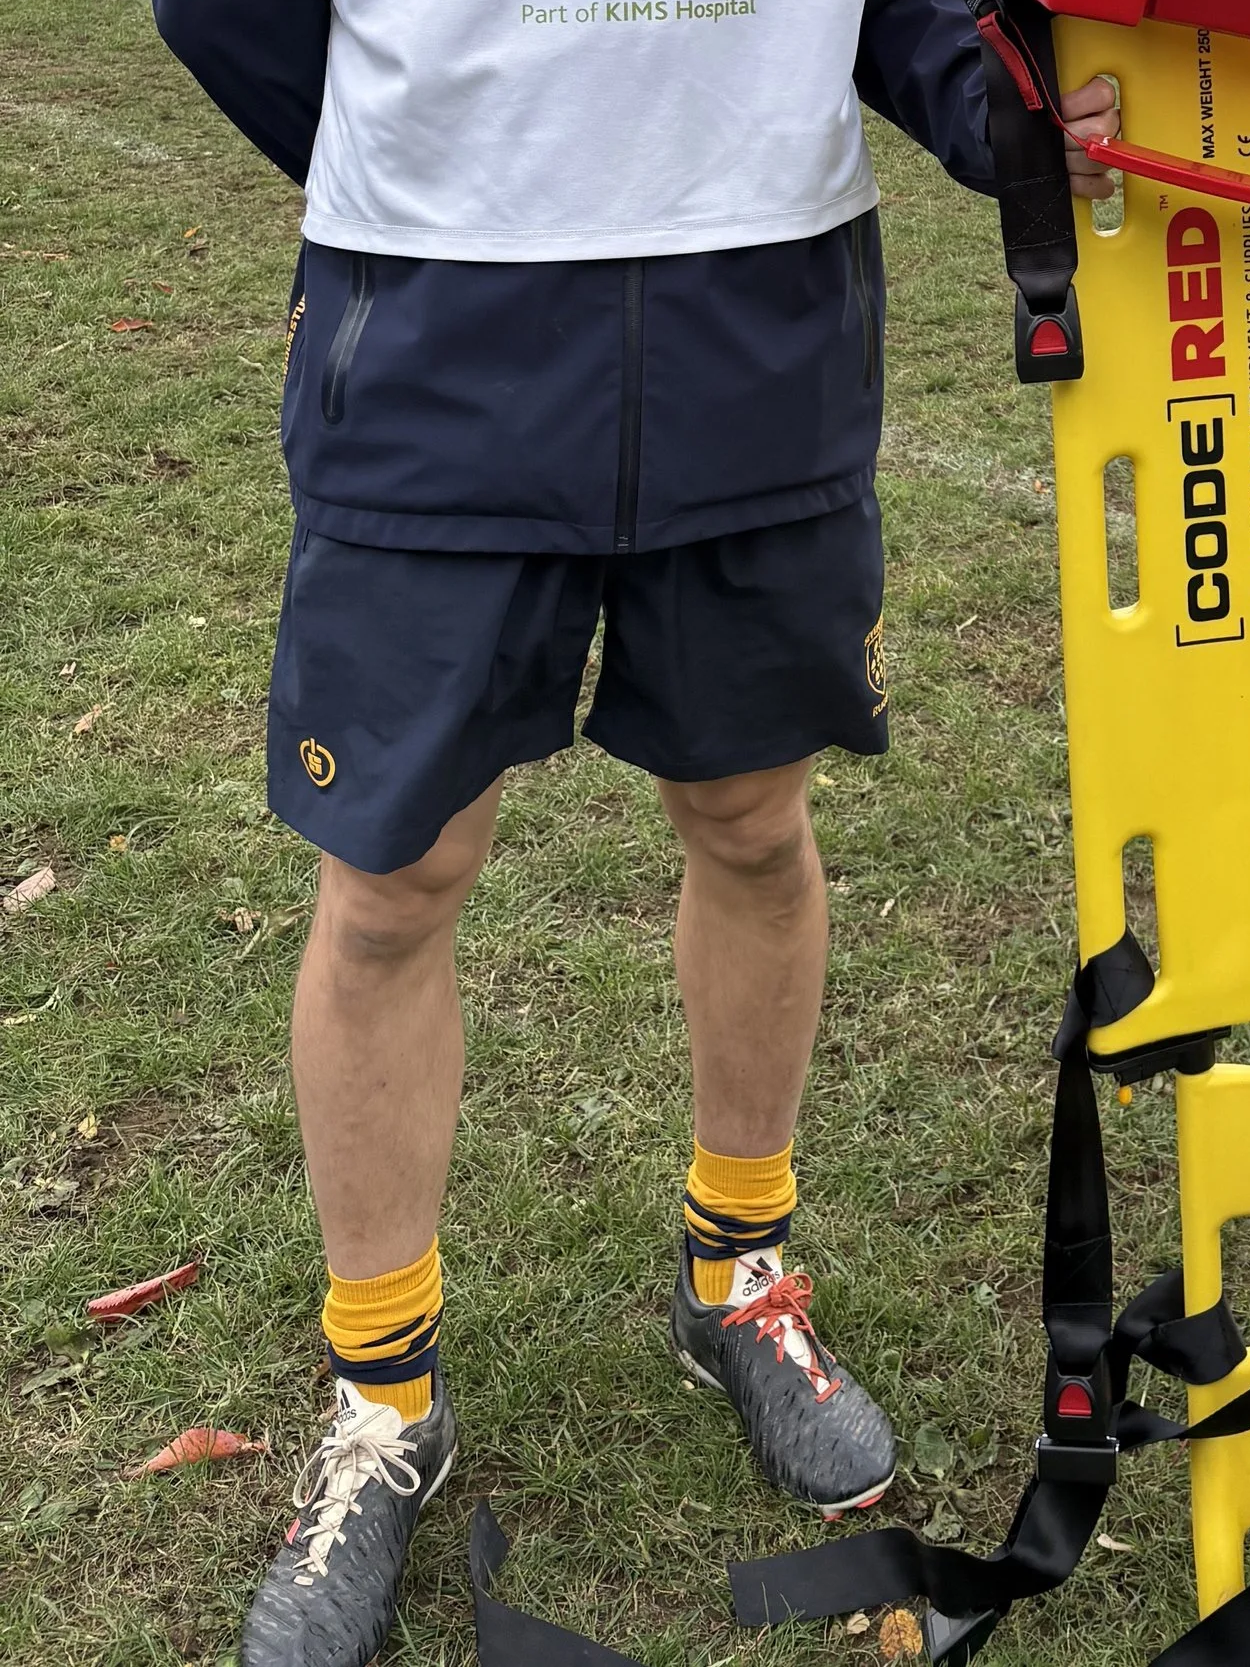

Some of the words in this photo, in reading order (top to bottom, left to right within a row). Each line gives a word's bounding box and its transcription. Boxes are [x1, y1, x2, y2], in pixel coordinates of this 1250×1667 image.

[522, 4, 567, 23] Part
[575, 2, 598, 22] of
[606, 1, 668, 22] KIMS
[1198, 28, 1211, 53] 250
[1199, 58, 1213, 120] WEIGHT
[1201, 124, 1215, 159] MAX
[1166, 206, 1226, 382] RED
